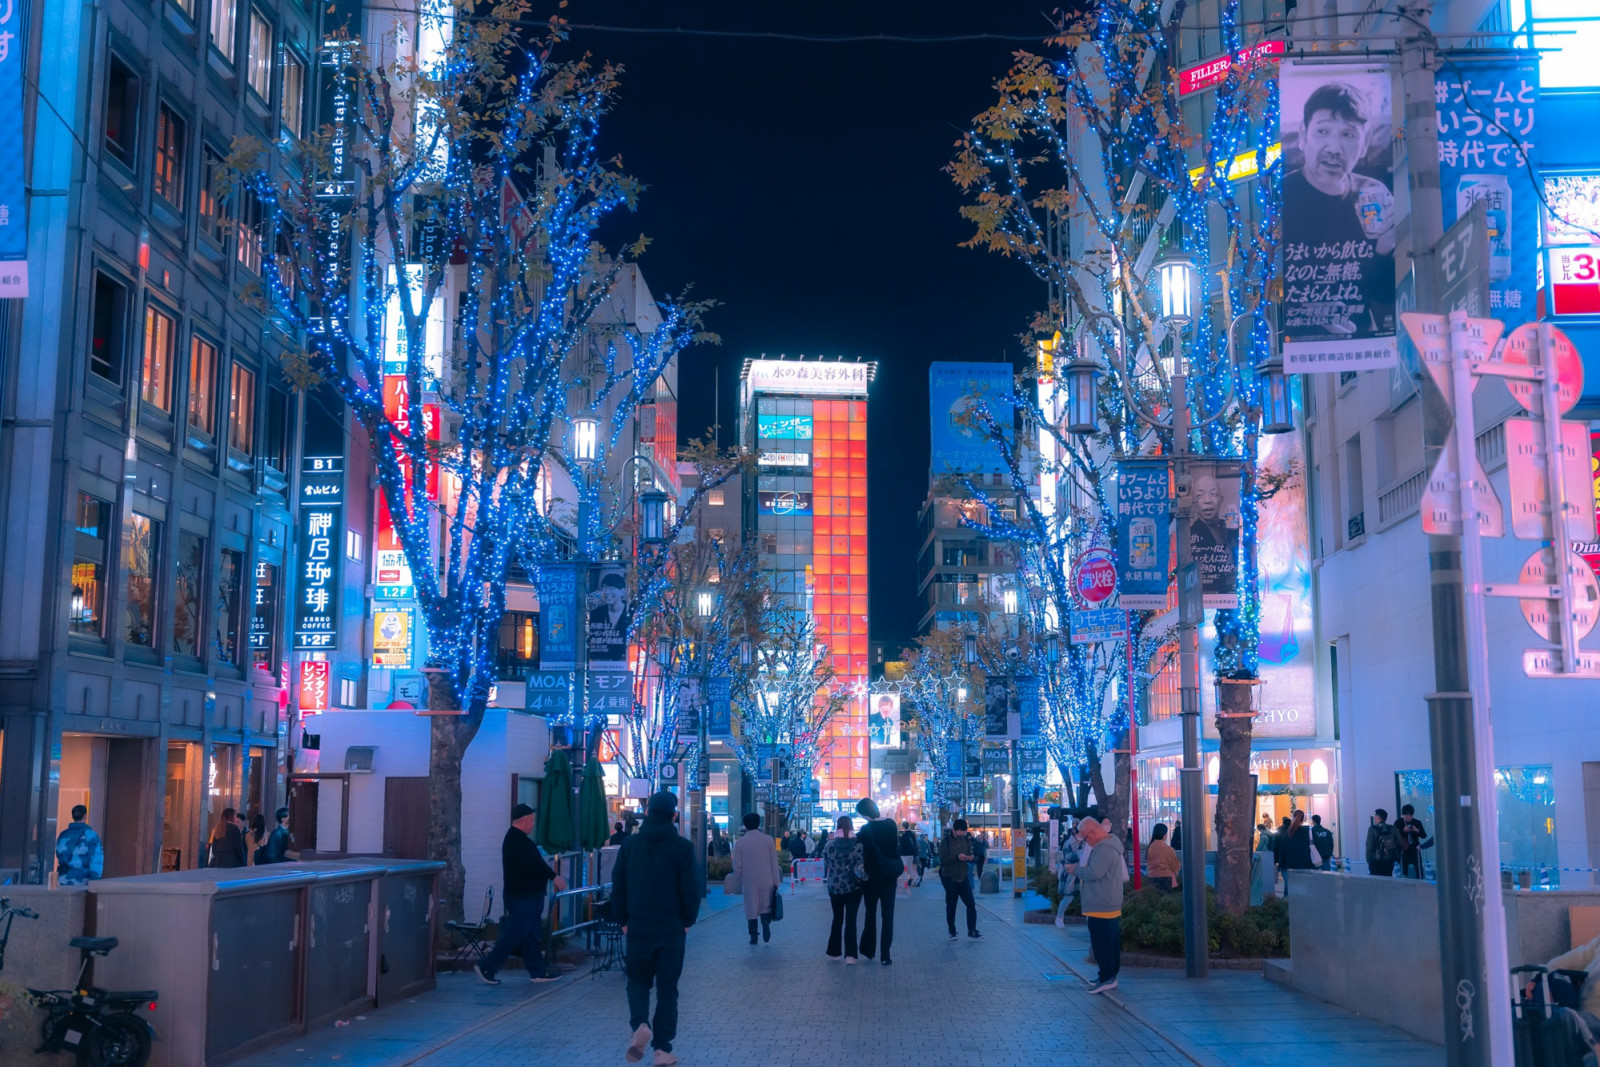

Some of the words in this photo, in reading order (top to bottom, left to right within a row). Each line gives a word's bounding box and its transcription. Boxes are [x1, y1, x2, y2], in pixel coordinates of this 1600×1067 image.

[1190, 59, 1231, 82] FILLER
[1434, 80, 1535, 105] #ブームと
[1436, 108, 1535, 137] いうより
[1438, 139, 1535, 168] 時代です
[1285, 240, 1374, 261] うまいから飲む。
[1441, 222, 1474, 283] モア
[1285, 261, 1363, 283] なのに無糖。
[1561, 255, 1571, 281] 当ビル
[1573, 253, 1600, 280] 3
[1285, 282, 1363, 303] たまらんよね。
[772, 366, 865, 381] 水の森美容外科
[313, 459, 333, 470] B1
[1119, 474, 1167, 485] #ブームと
[1120, 487, 1167, 500] いうより
[1119, 502, 1167, 516] 時代です
[1573, 541, 1600, 554] Din
[305, 512, 332, 613] 神乃珈琲
[541, 583, 576, 593] いうより
[1080, 568, 1114, 590] 消火栓
[303, 662, 314, 692] レンズ
[314, 662, 326, 709] コンタクト
[529, 675, 566, 689] MOA
[594, 675, 628, 689] モア
[593, 694, 629, 711] 4番街
[985, 750, 1007, 759] MOA
[1023, 750, 1043, 759] モア
